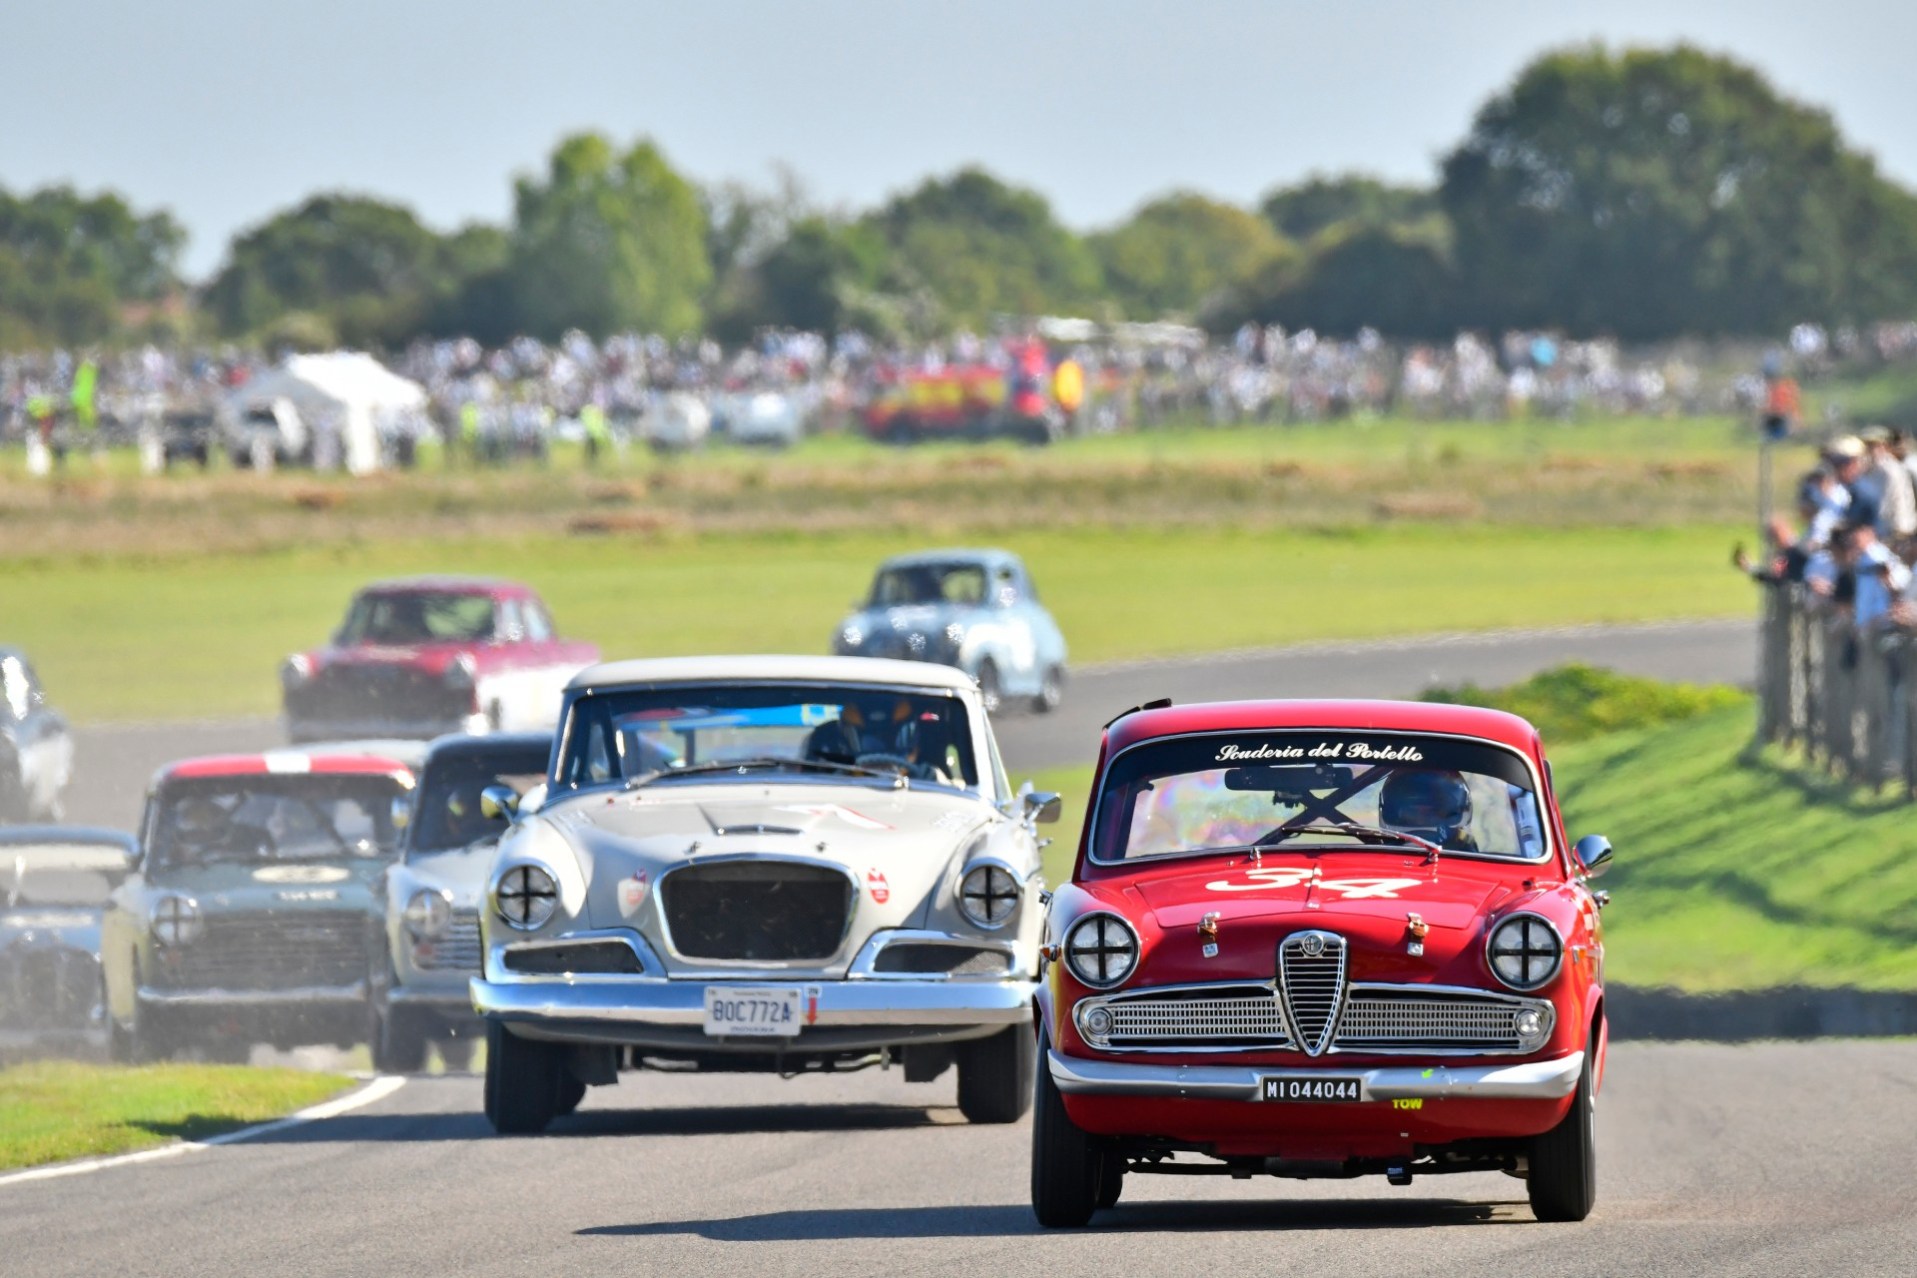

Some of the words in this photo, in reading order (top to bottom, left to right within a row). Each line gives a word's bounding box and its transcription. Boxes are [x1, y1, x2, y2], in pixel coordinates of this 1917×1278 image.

[1215, 743, 1304, 761] Scuderia
[1308, 742, 1344, 758] del
[1346, 742, 1424, 762] Portello
[1205, 867, 1422, 898] 34
[1289, 1081, 1358, 1098] 044044
[1392, 1098, 1424, 1110] TOW
